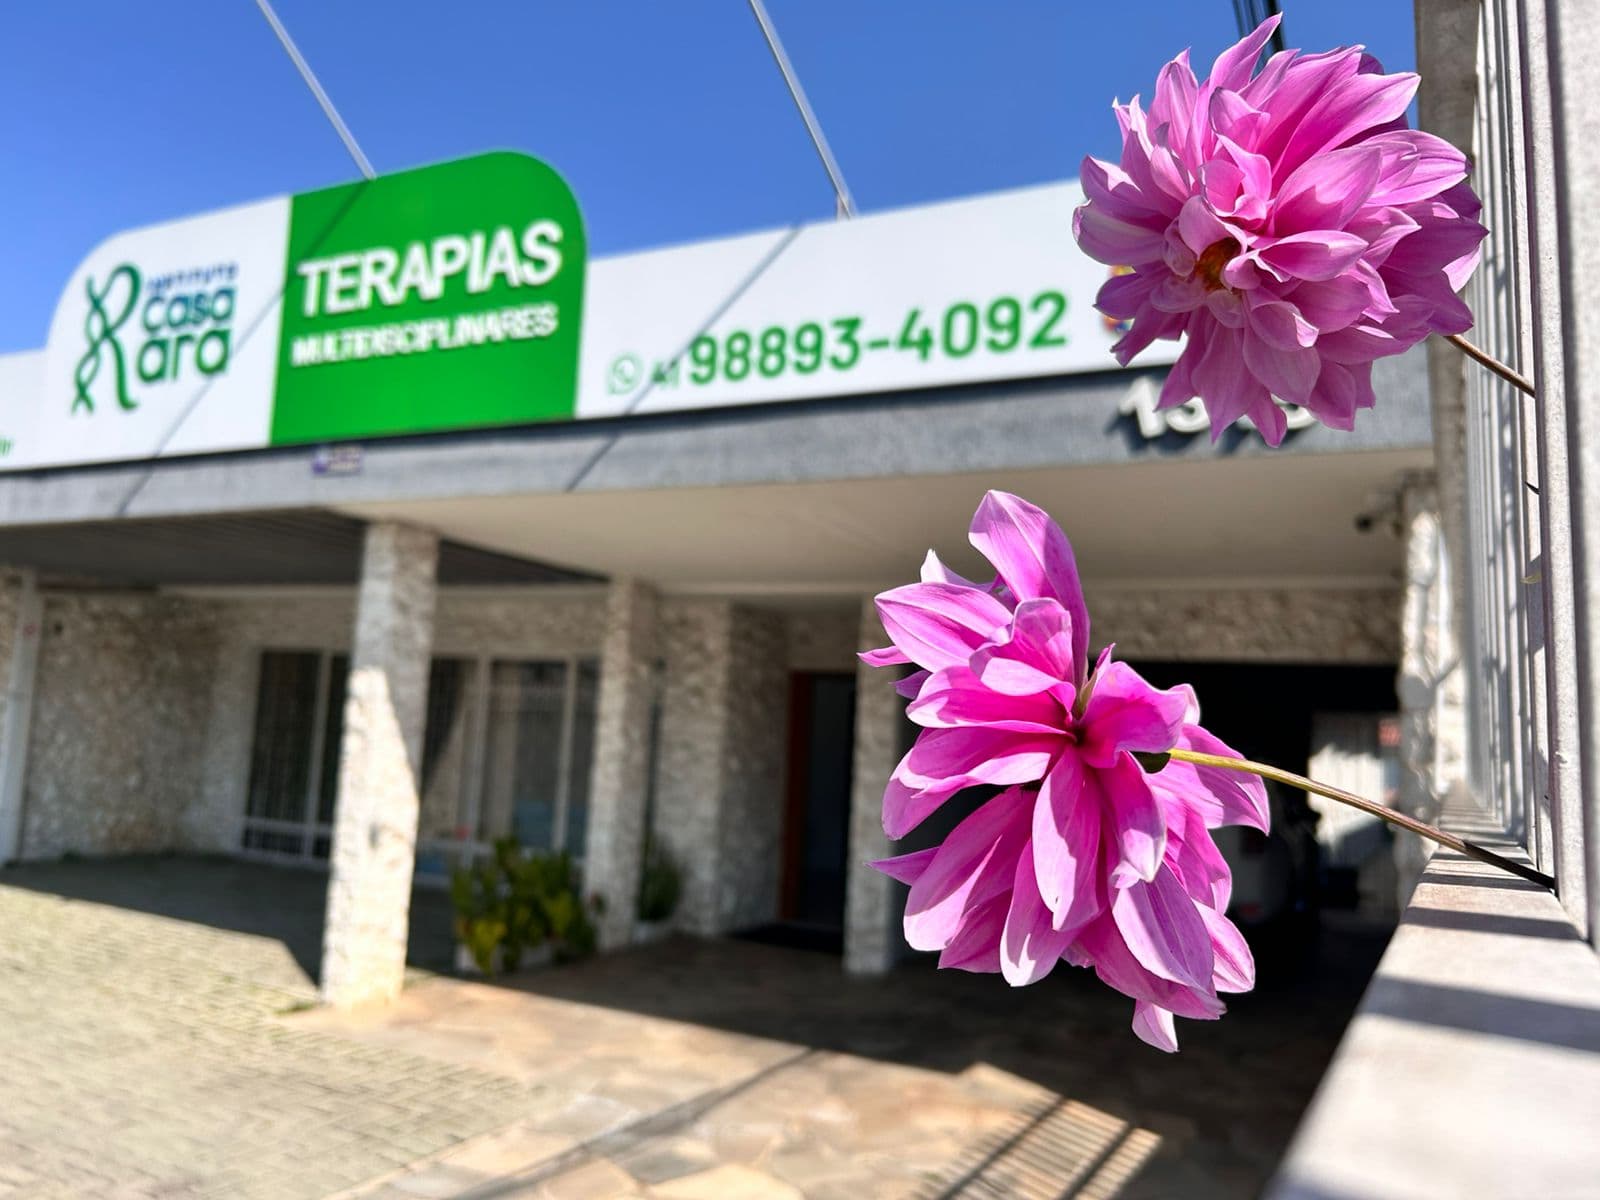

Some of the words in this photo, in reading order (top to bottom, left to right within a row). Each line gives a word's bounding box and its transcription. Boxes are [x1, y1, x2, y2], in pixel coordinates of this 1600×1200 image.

[297, 219, 564, 318] TERAPIAS
[143, 288, 235, 332] casa
[689, 290, 1068, 386] 98893-4092
[138, 328, 231, 384] ara
